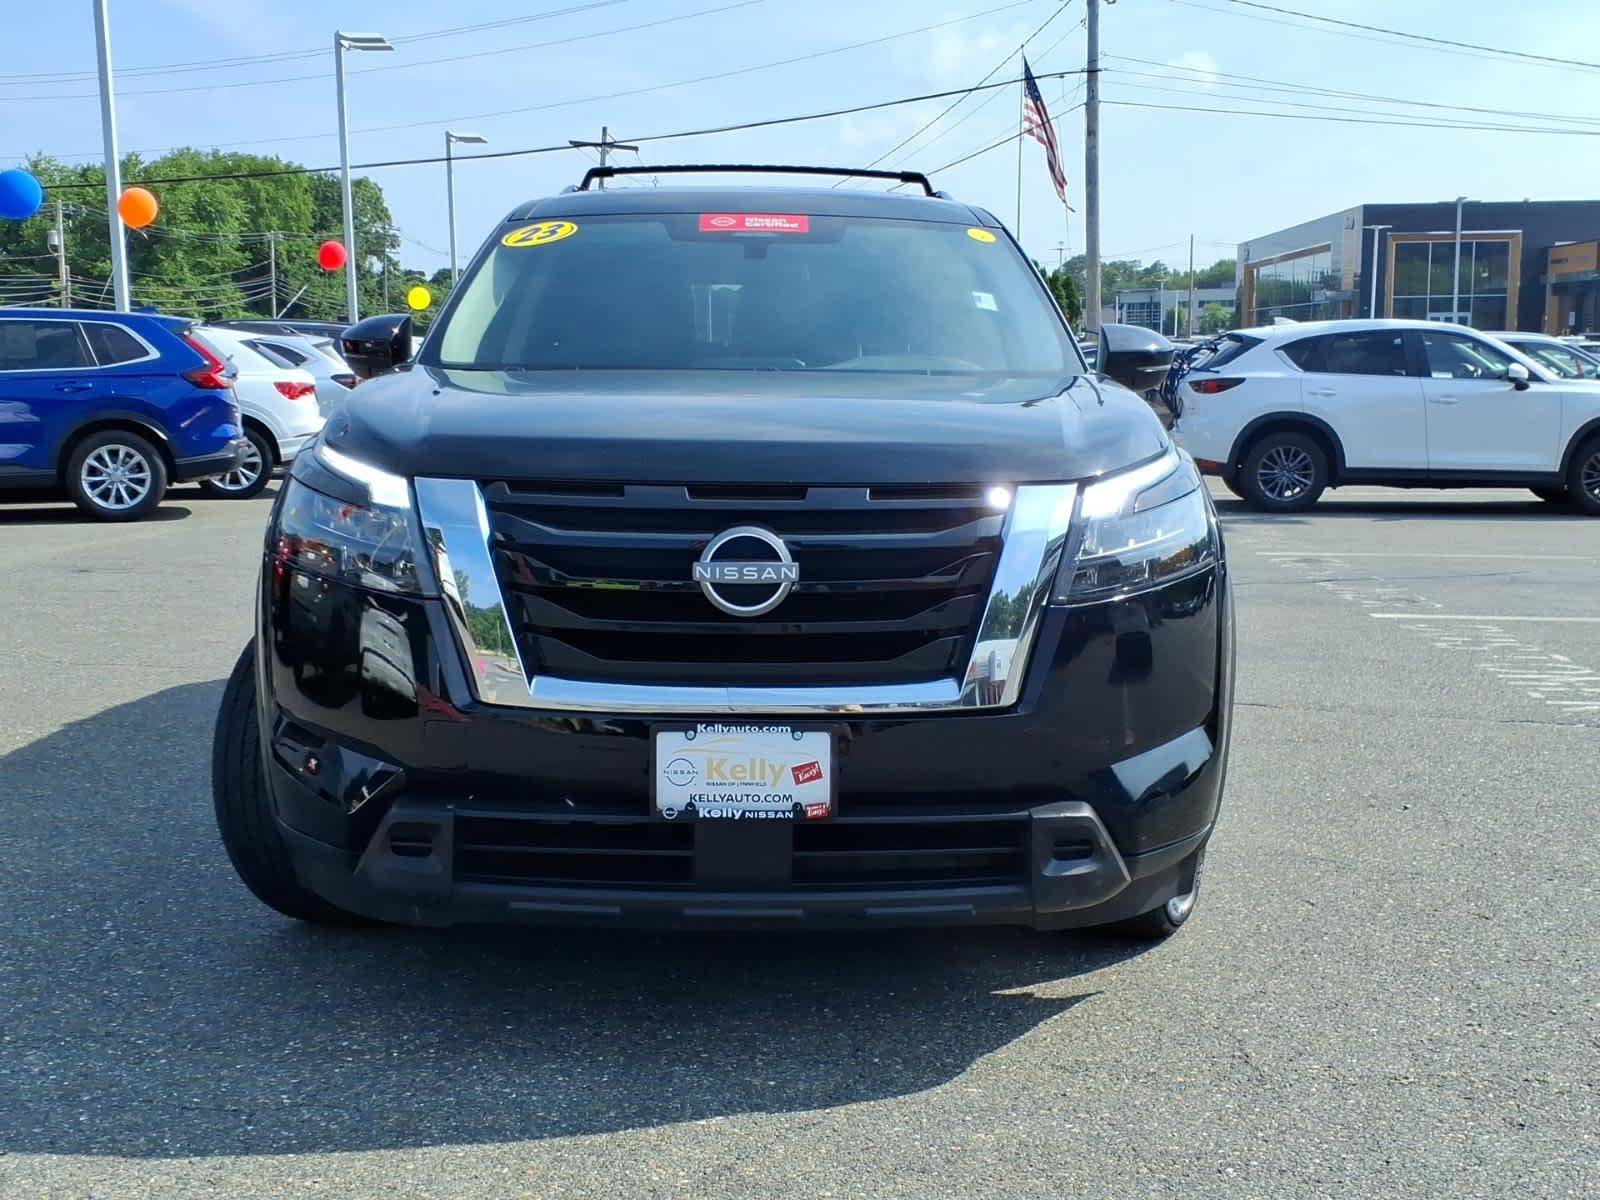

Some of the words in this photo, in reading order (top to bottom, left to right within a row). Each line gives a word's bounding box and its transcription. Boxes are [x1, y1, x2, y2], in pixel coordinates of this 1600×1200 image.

[511, 223, 565, 244] 23
[695, 566, 796, 580] NISSAN
[697, 724, 791, 734] Kellyauto.com
[706, 757, 787, 789] Kelly
[690, 793, 793, 803] KELLYAUTO.COM
[699, 807, 744, 820] Kelly
[745, 811, 794, 819] NISSAN
